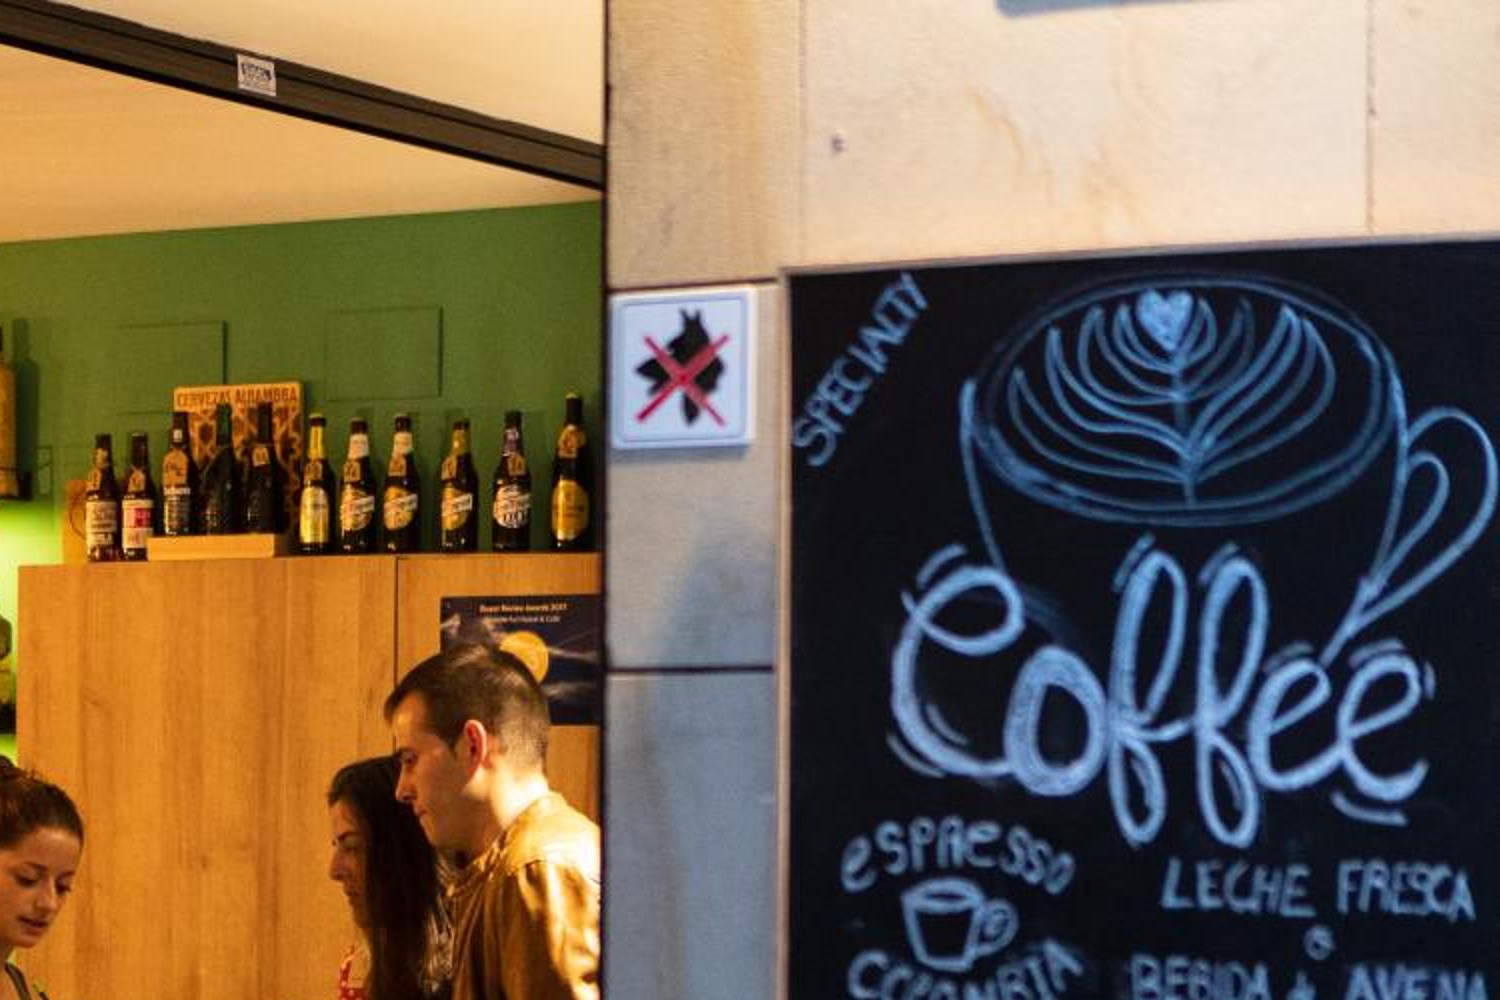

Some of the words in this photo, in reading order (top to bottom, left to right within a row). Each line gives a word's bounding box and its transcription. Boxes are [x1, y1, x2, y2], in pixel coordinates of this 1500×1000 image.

[792, 272, 929, 467] SPECIALTY
[889, 545, 1430, 847] Coffee
[1160, 857, 1315, 917] LECHE
[1336, 859, 1477, 921] FRESCA
